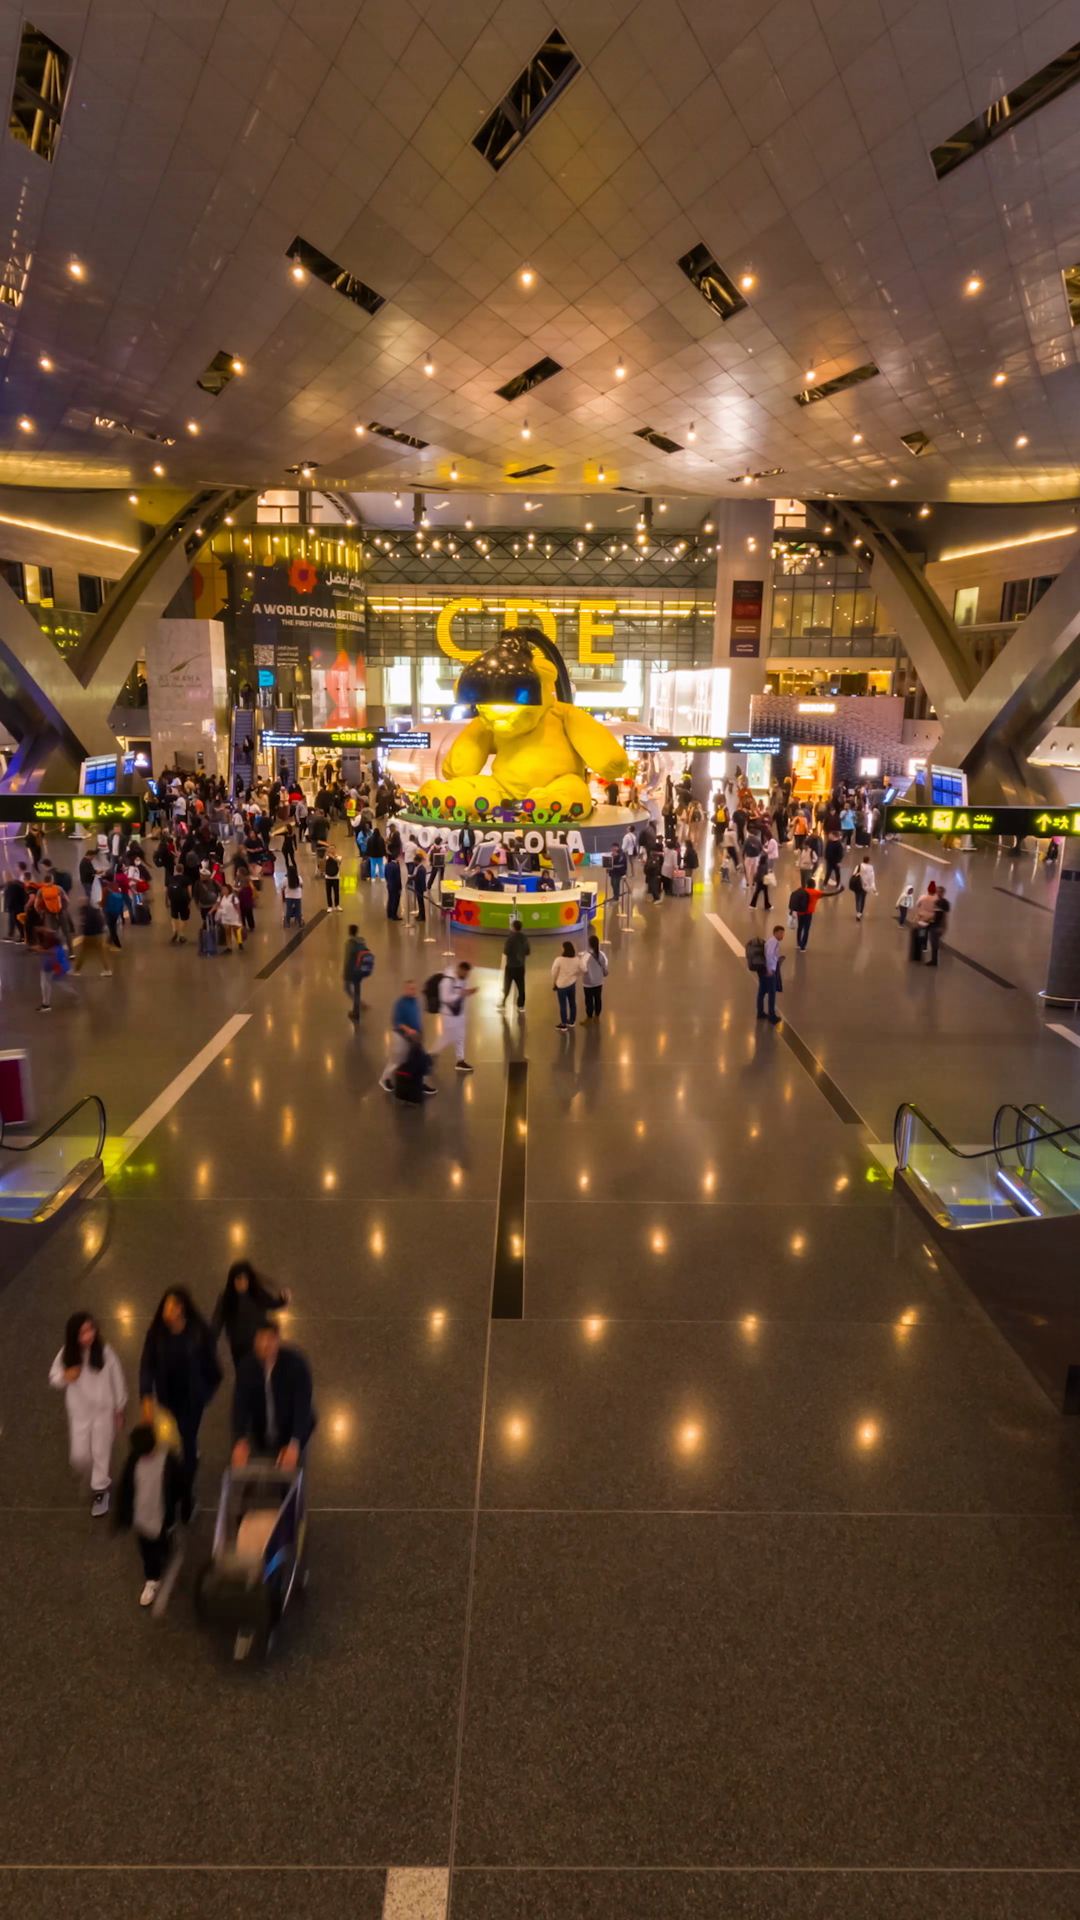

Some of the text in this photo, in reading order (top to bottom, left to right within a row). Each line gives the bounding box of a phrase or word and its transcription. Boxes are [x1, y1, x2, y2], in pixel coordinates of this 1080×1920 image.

[252, 603, 262, 614] A
[263, 604, 308, 617] WORLD
[309, 607, 330, 619] FOR
[329, 608, 336, 619] A
[336, 609, 359, 621] BETTER
[281, 618, 294, 627] THE
[295, 619, 312, 628] FIRST
[173, 674, 201, 682] MAHA
[55, 801, 70, 817] B
[955, 813, 970, 829] A
